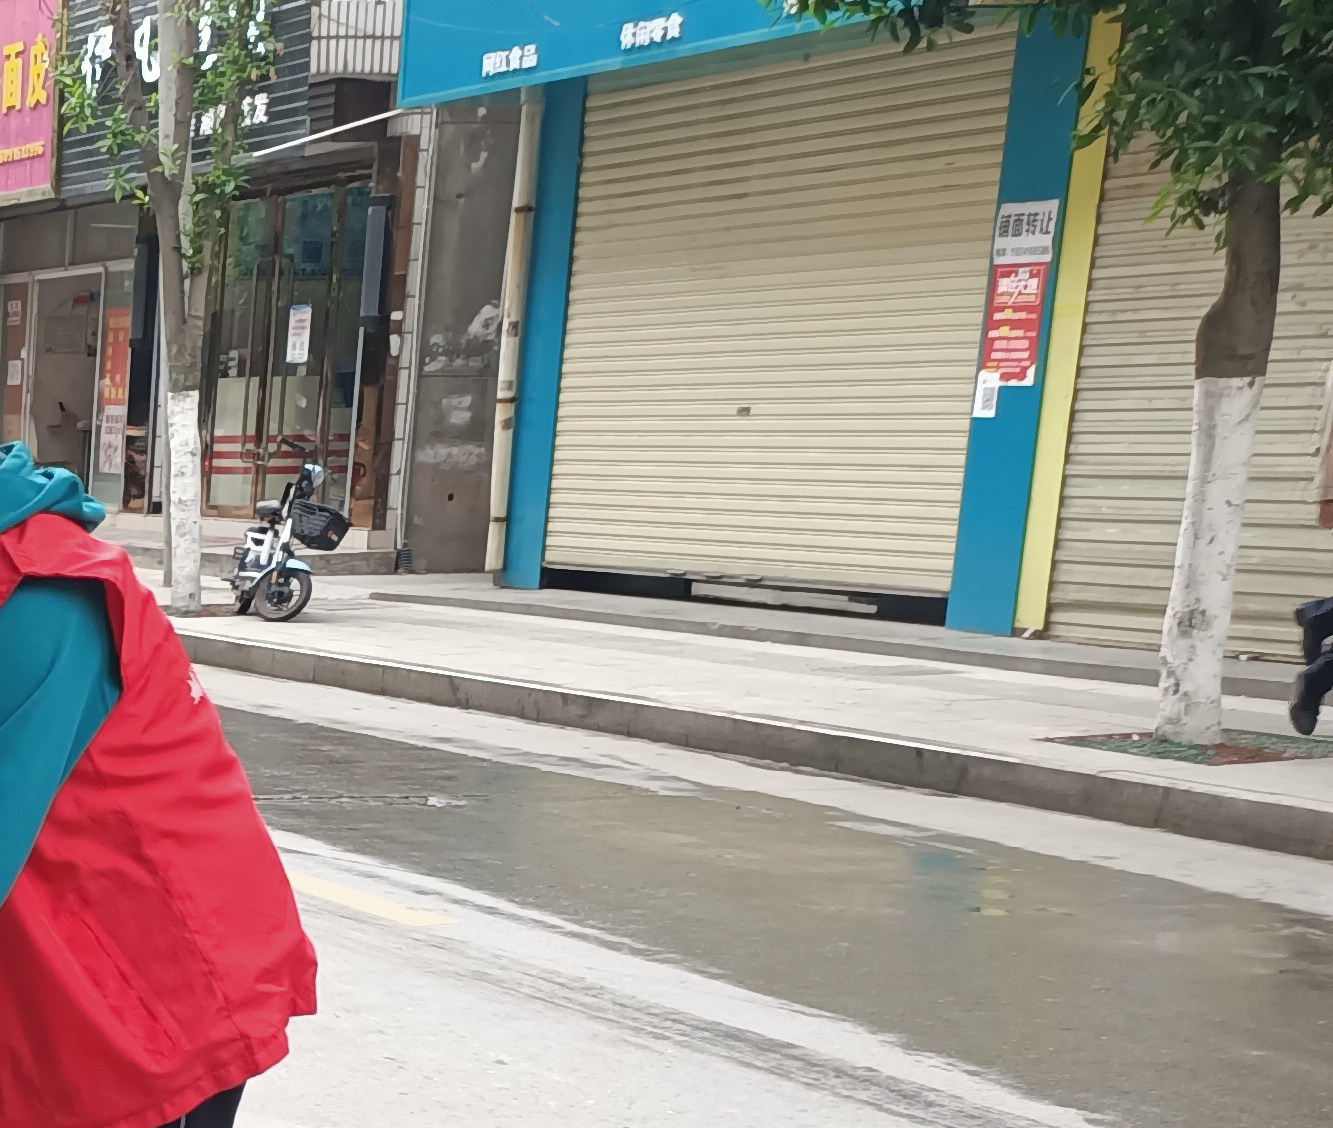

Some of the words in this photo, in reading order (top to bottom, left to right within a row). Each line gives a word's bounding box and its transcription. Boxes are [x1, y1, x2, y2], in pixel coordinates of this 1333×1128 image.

[620, 12, 684, 50] 休闲零食
[482, 44, 538, 77] 网红食品
